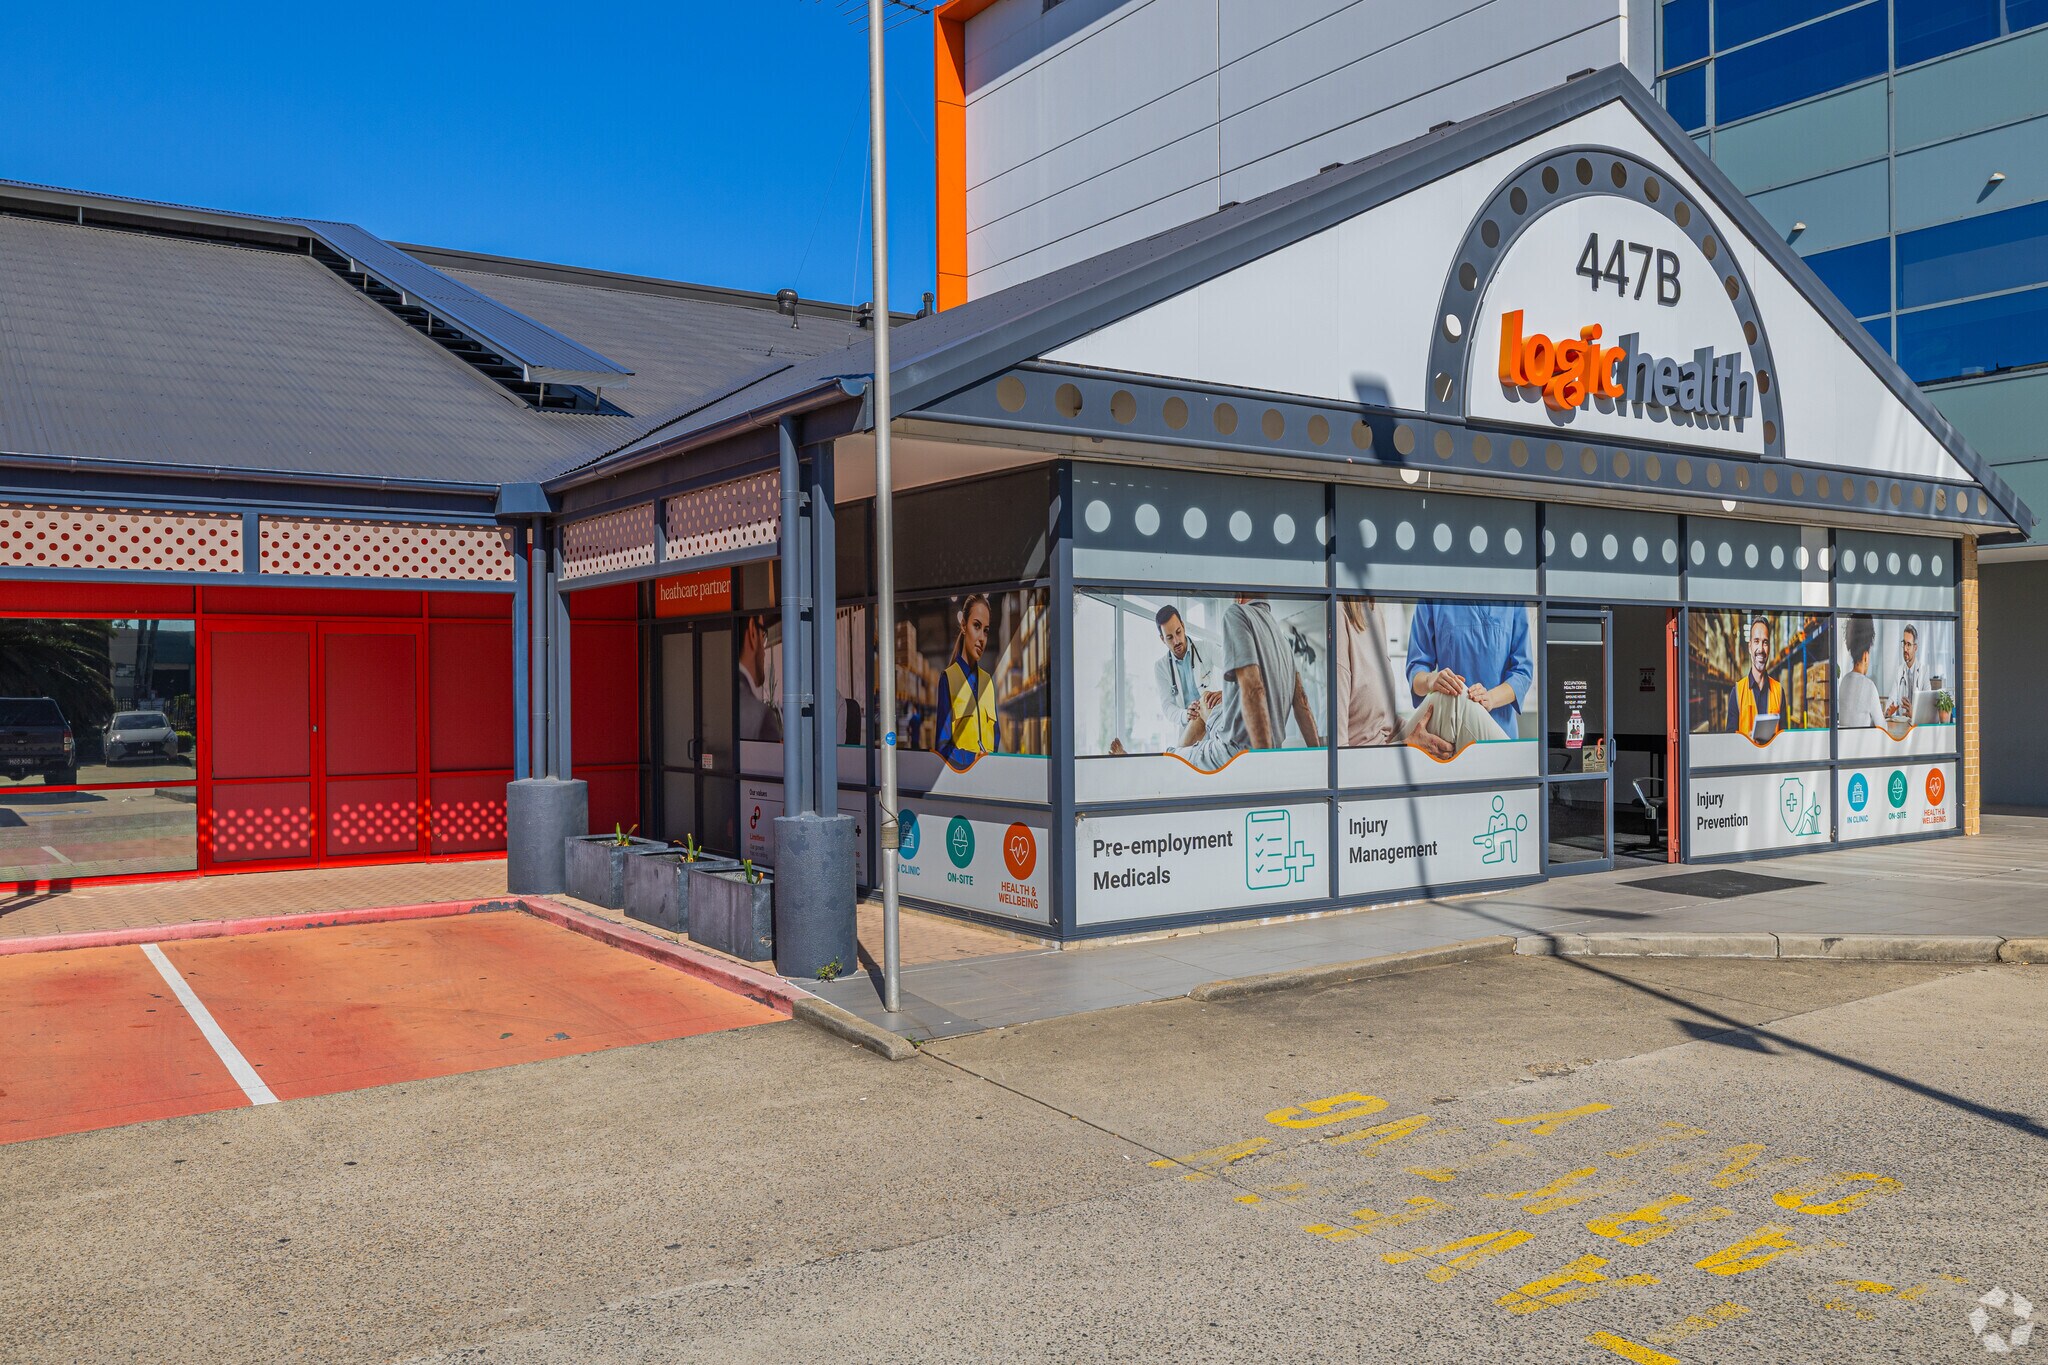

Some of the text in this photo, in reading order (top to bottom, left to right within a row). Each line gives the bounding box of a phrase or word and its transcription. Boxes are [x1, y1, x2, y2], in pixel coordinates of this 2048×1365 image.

[1576, 232, 1682, 307] 447B
[1498, 308, 1755, 420] logichealth
[660, 580, 731, 600] heathcare partner
[1696, 791, 1725, 808] Injury
[1696, 812, 1749, 832] Prevention
[1847, 814, 1868, 824] IN CLINIC
[1888, 812, 1907, 820] ON-SITE
[1922, 816, 1946, 824] WELLBEING
[1923, 809, 1940, 817] HEALTH
[1348, 816, 1389, 837] Injury
[1092, 829, 1234, 859] Pre-employment
[1348, 840, 1438, 865] Management
[901, 864, 920, 876] CLINIC
[947, 872, 974, 886] ON-SITE
[1092, 866, 1172, 892] Medicals
[1001, 881, 1037, 897] HEALTH &
[998, 892, 1039, 910] WELLBEING
